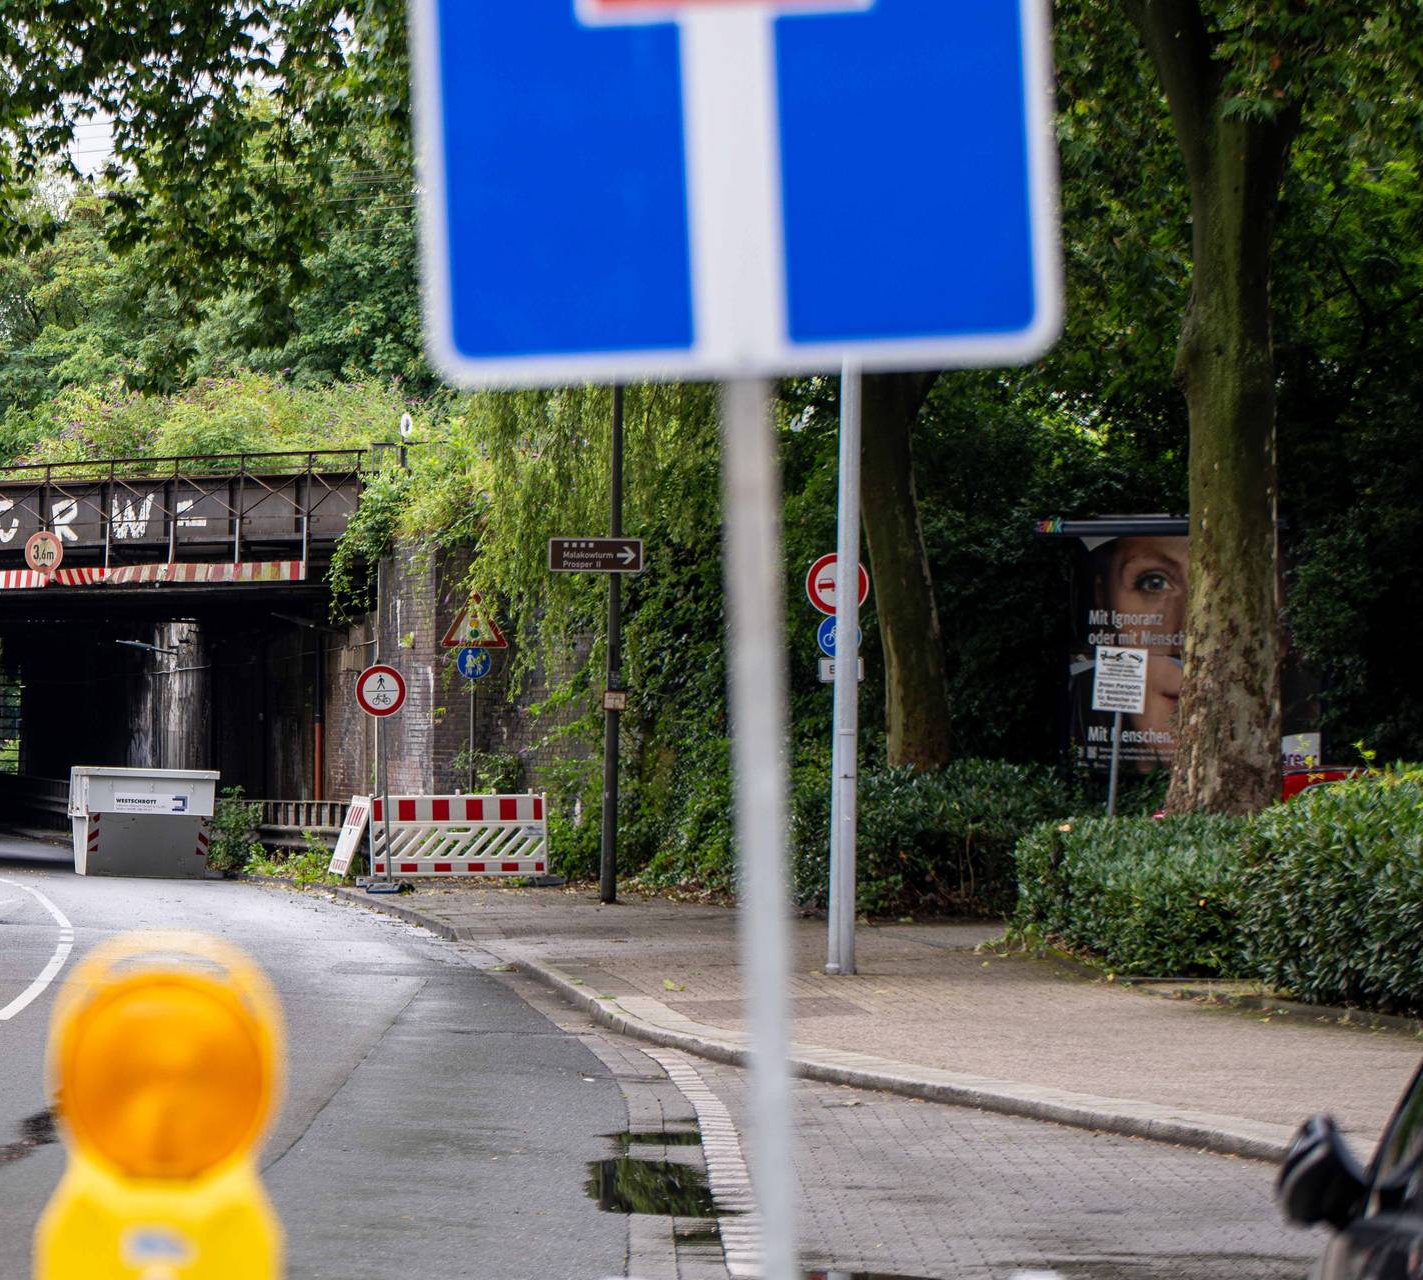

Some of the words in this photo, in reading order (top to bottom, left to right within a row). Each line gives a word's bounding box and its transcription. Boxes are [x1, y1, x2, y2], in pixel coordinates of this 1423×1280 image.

[562, 551, 614, 559] Malakowturm
[562, 560, 593, 569] Prosper
[595, 560, 602, 568] II
[1088, 610, 1108, 625] Mit
[1111, 610, 1163, 628] Ignoranz
[1088, 630, 1116, 645] oder
[1118, 630, 1137, 645] mit
[1140, 631, 1185, 646] Mensch
[1088, 726, 1108, 742] Mit
